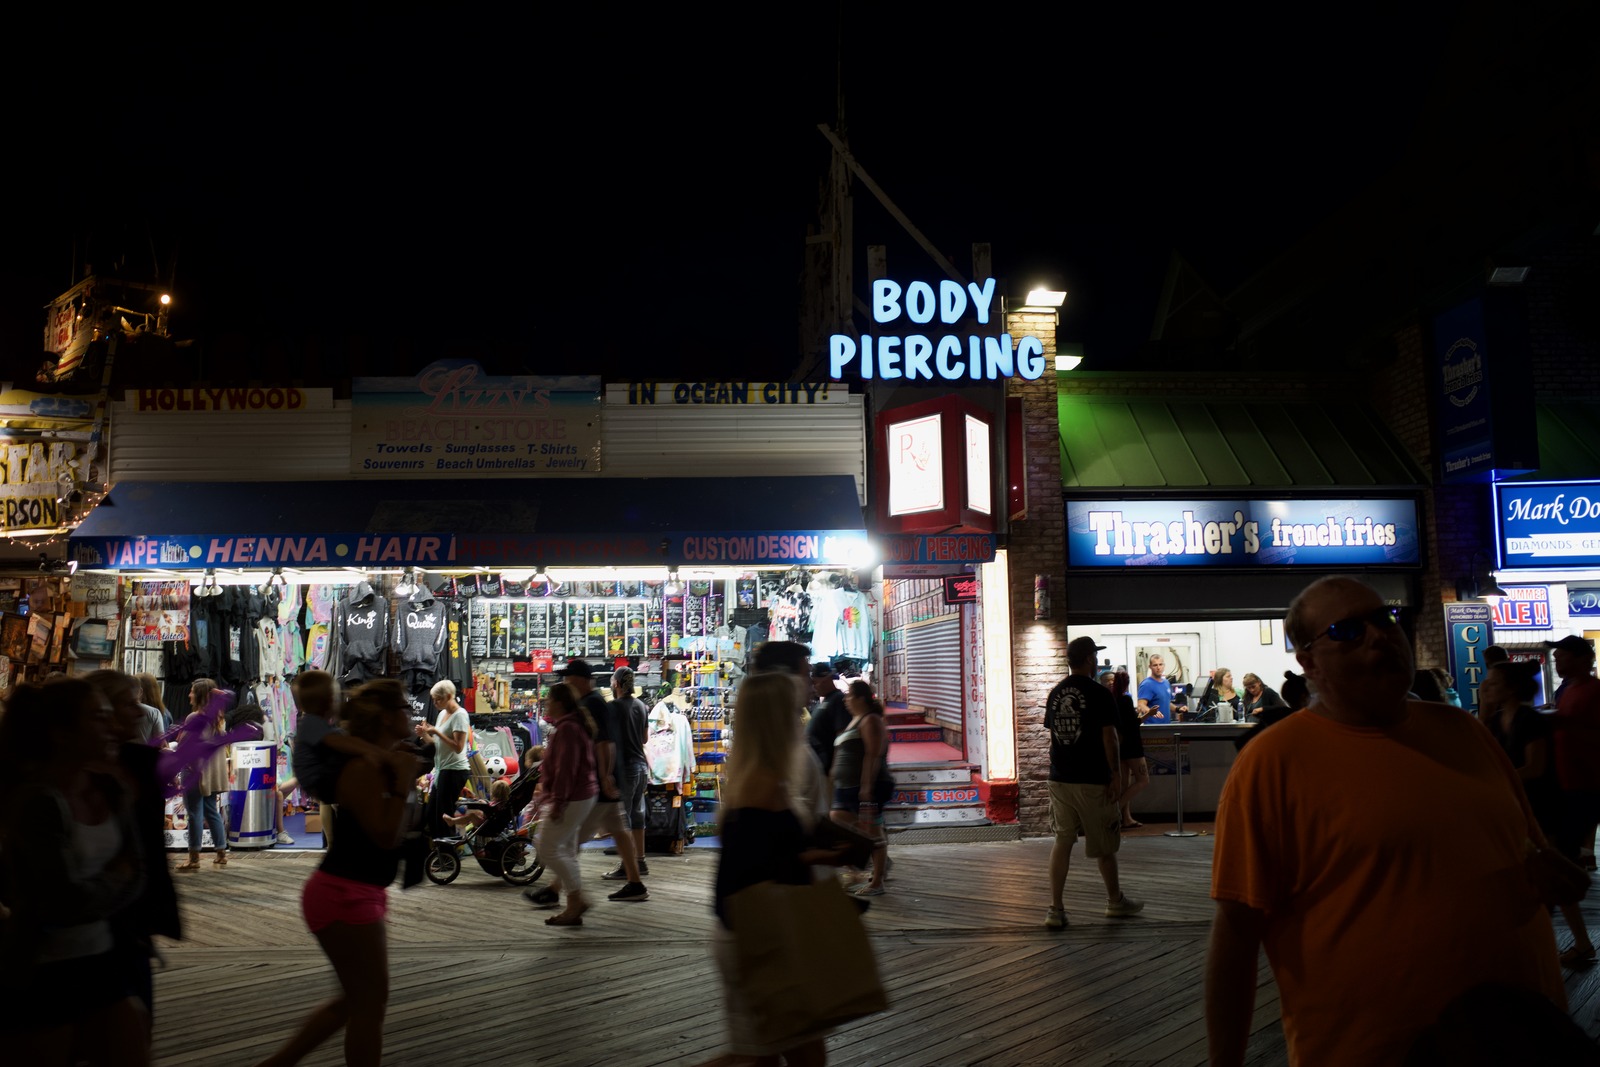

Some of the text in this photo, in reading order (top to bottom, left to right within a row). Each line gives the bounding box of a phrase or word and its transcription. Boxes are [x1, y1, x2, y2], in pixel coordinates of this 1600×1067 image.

[872, 277, 997, 325] BODY
[829, 332, 1047, 381] PIERCING
[138, 388, 303, 411] HOLLYWOOD
[402, 364, 551, 417] Lizzy's
[629, 381, 829, 405] IN OCEAN CITY!
[385, 419, 567, 441] BEACH STORE
[376, 443, 433, 454] Towels
[445, 443, 516, 456] Sunglasses
[363, 457, 588, 471] Souvenirs Beach Umbrellas Jewelry
[1507, 493, 1569, 525] Mark
[1088, 509, 1396, 555] Thrasher's french fries
[105, 540, 158, 566] VAPE
[206, 537, 328, 564] HENNA
[354, 536, 443, 562] HAIR
[683, 535, 819, 561] CUSTOM DESIGN
[883, 536, 992, 561] BODY PIERCING
[1511, 540, 1572, 550] DIAMONDS
[346, 611, 377, 630] King
[1492, 603, 1531, 624] ALE
[969, 603, 979, 702] IERCING
[896, 731, 940, 741] PIERCING
[932, 789, 977, 801] SHOP
